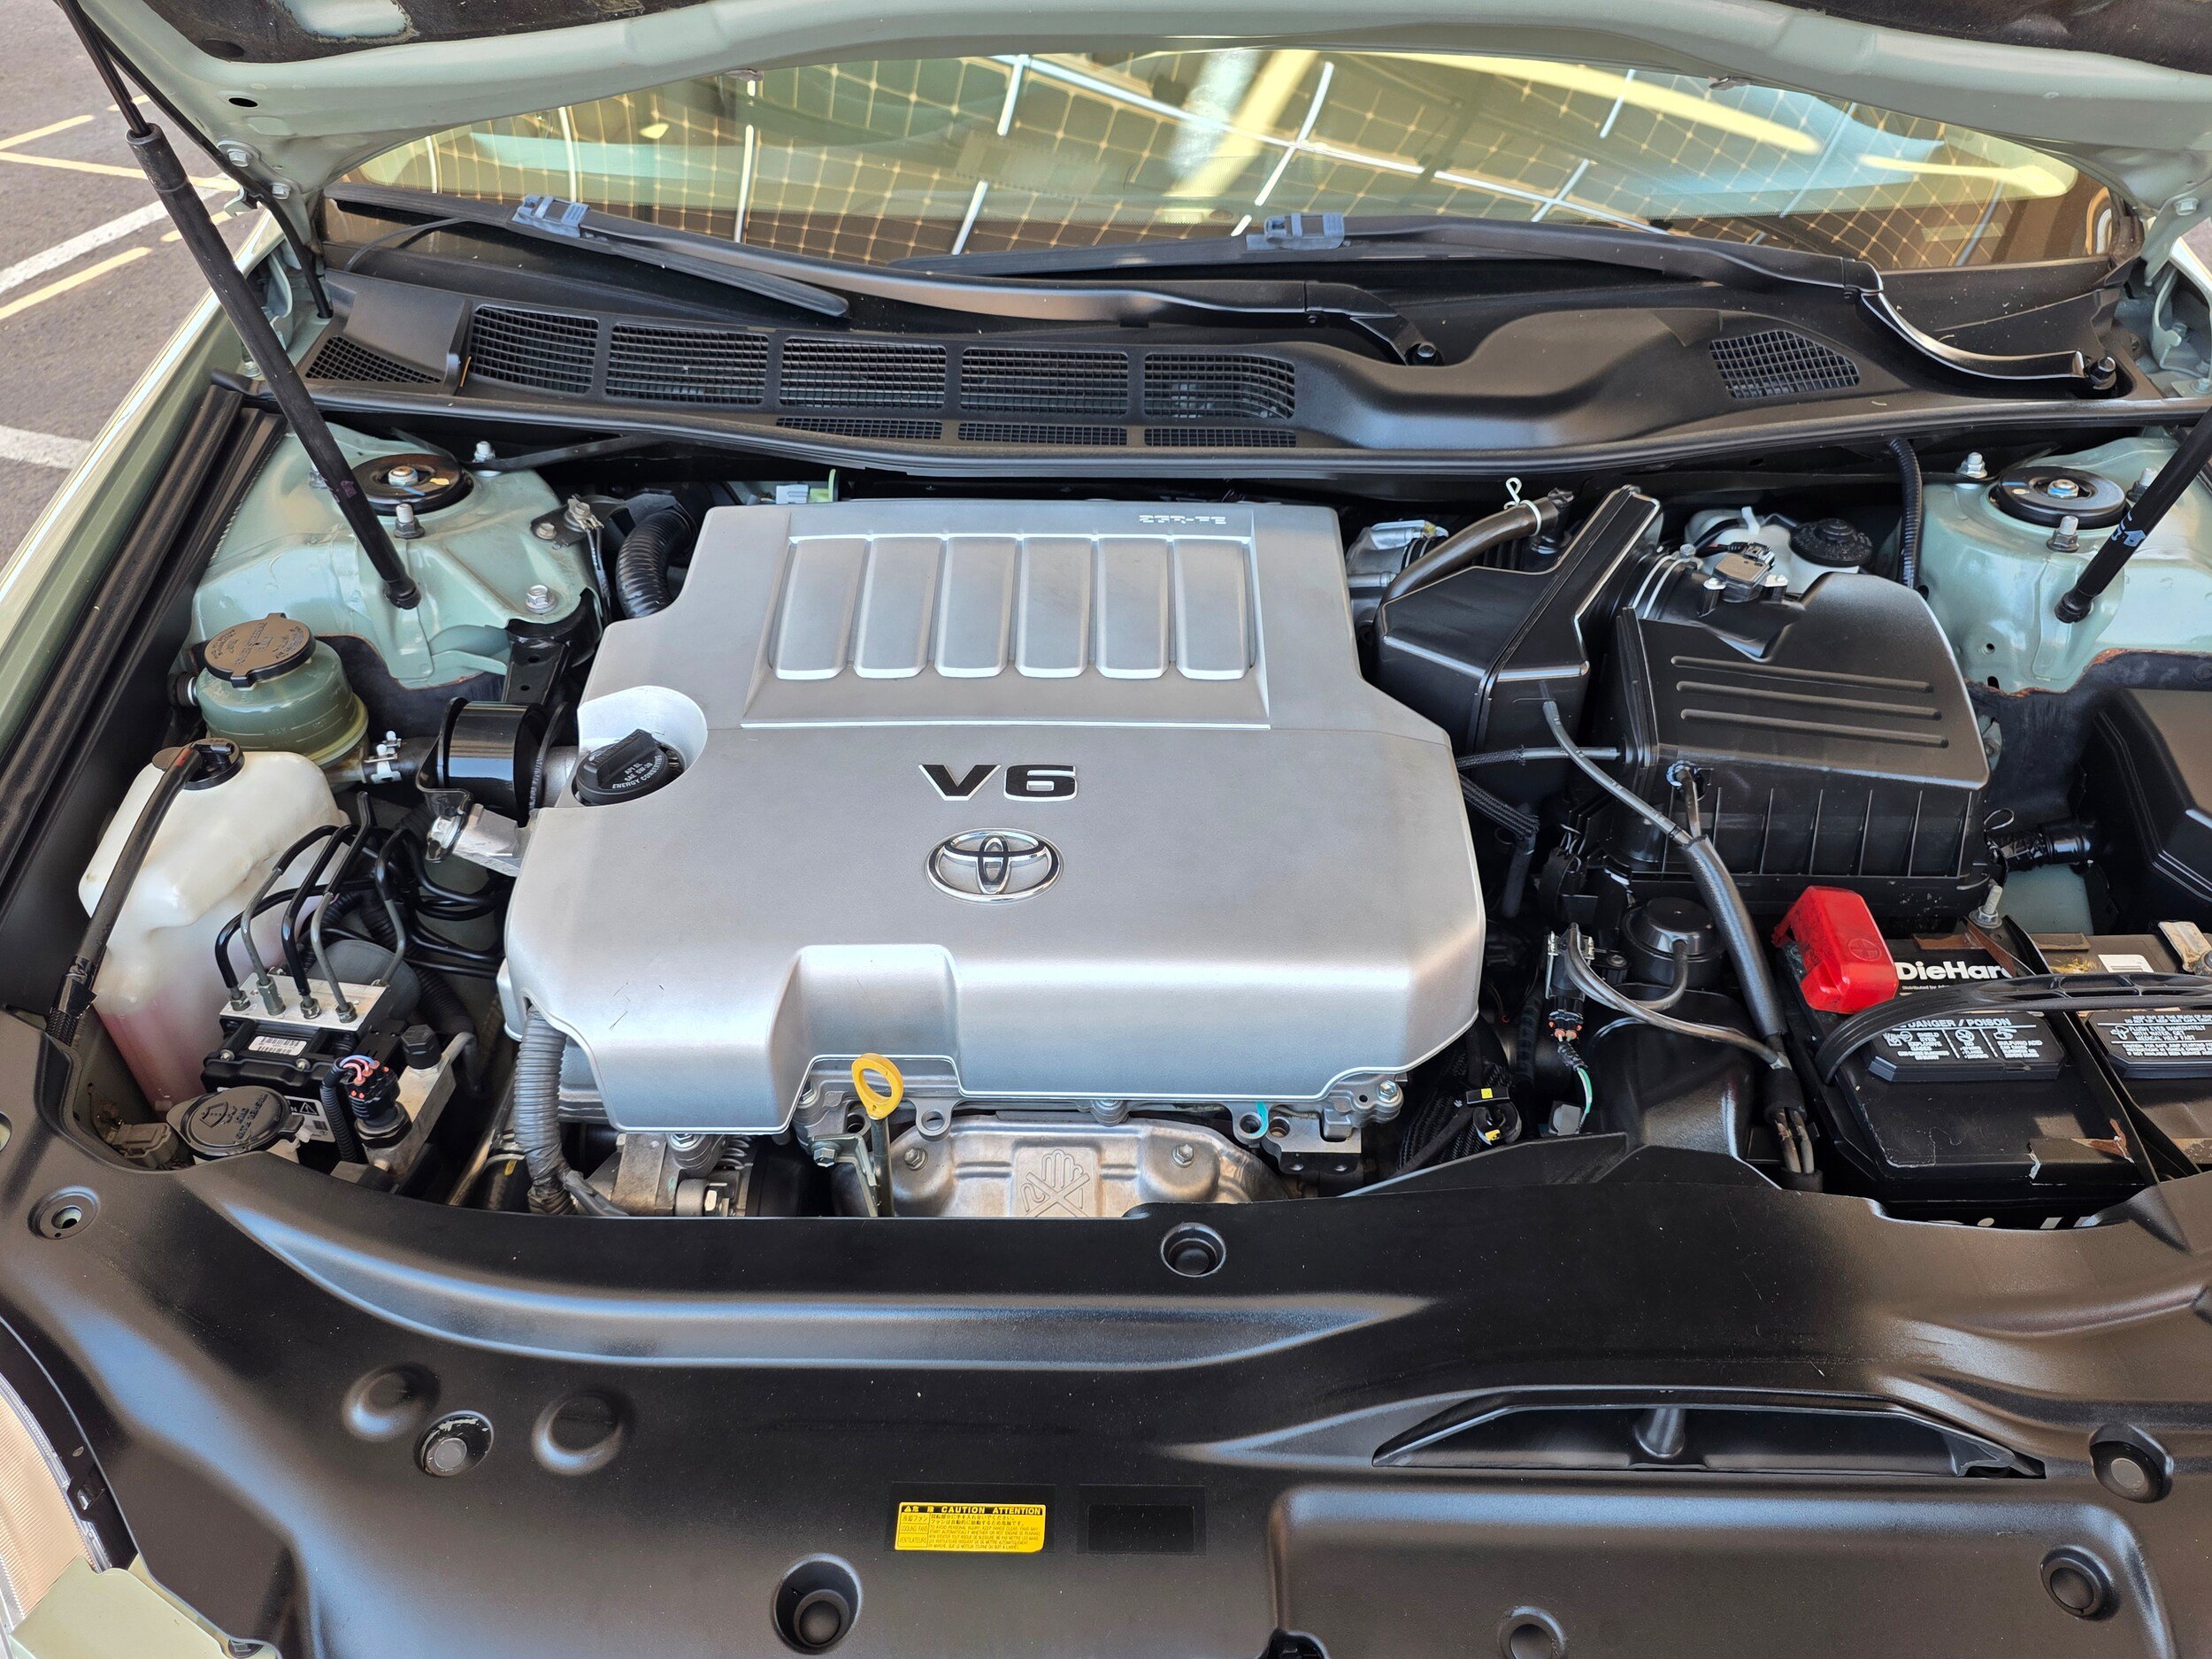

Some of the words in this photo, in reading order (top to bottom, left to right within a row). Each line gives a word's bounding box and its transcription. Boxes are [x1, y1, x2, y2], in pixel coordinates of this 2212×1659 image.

[1139, 515, 1226, 525] 2GR-FE
[612, 779, 640, 788] ENERGY
[641, 755, 663, 781] CONSERVING
[918, 764, 1079, 803] V6
[1965, 1018, 2012, 1027] POISON
